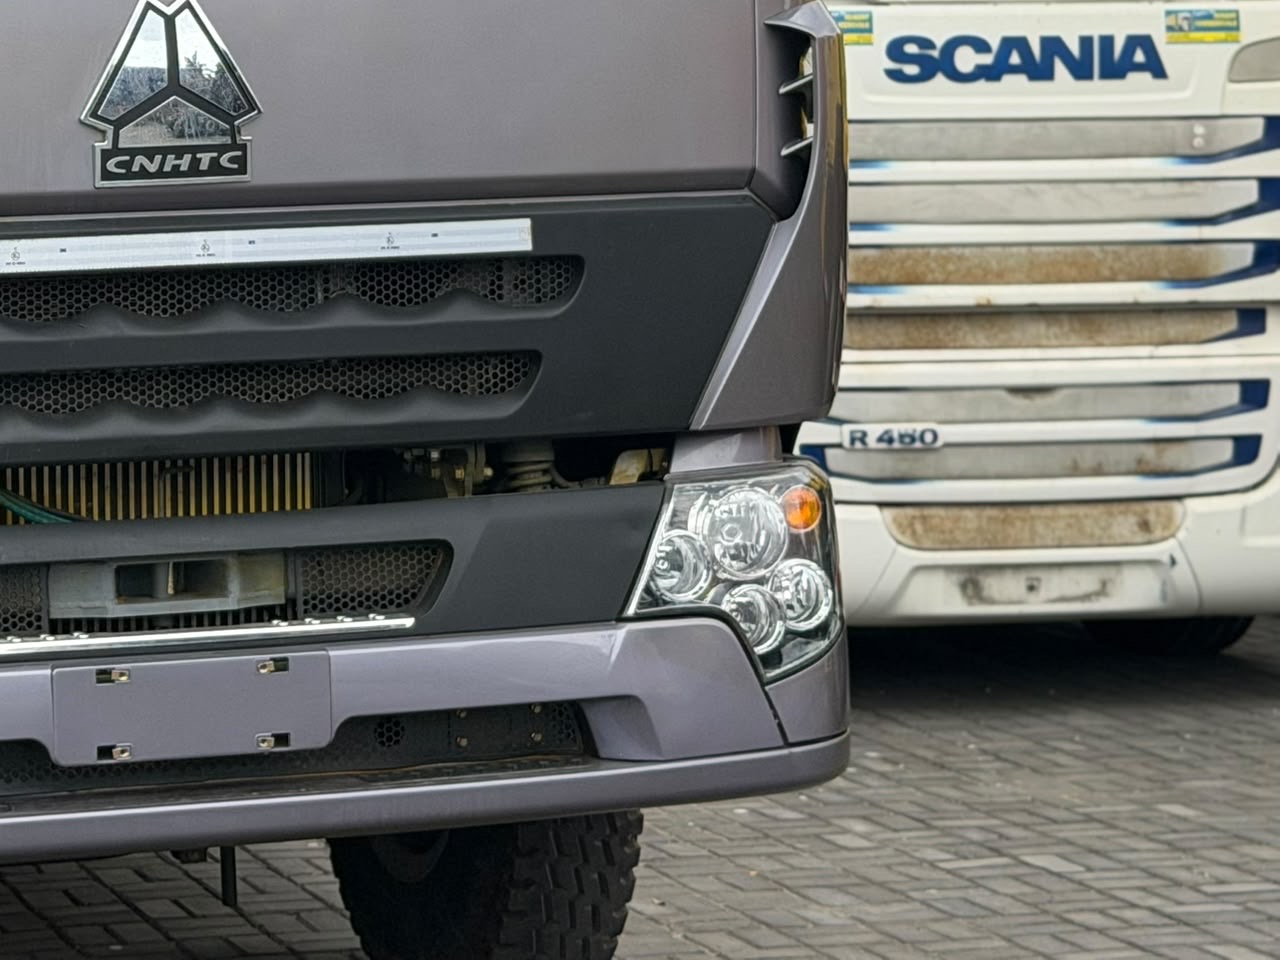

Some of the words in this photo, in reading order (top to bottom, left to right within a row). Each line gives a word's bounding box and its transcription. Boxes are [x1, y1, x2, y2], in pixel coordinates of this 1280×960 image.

[883, 34, 1169, 84] SCANIA
[106, 150, 242, 173] CNHTC
[849, 429, 868, 446] R
